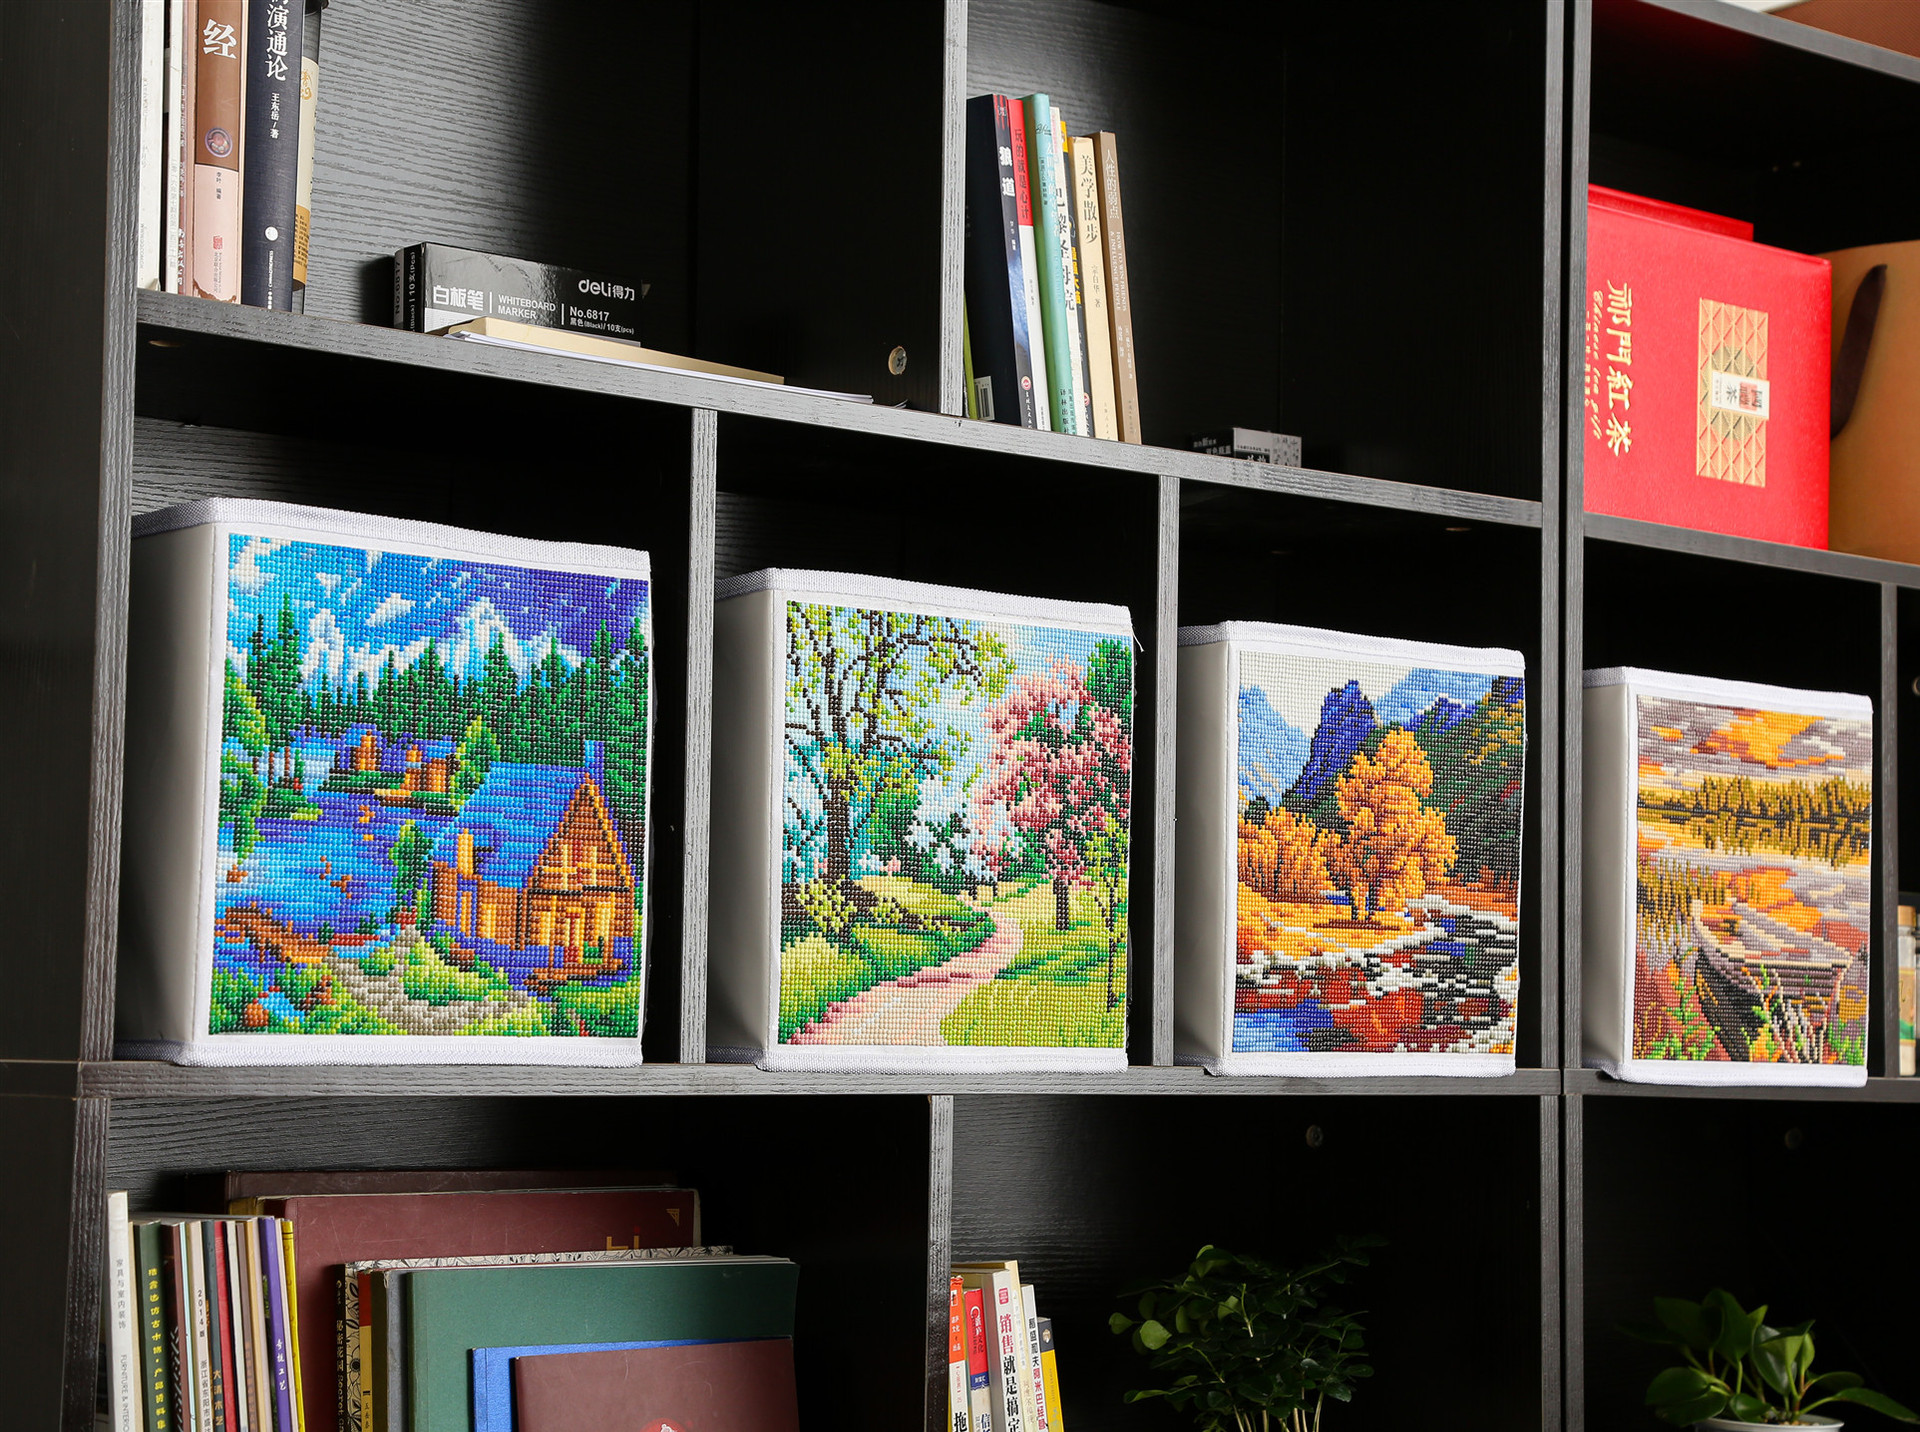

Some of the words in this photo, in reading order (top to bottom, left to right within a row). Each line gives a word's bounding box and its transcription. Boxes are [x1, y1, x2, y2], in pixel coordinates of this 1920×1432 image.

[203, 19, 237, 59] 经
[265, 0, 290, 81] 演通论
[1081, 154, 1099, 245] 美学散步
[1105, 149, 1120, 219] 人性的弱点
[433, 285, 484, 311] 白板笔
[498, 294, 556, 312] WHITEBOARD
[498, 305, 537, 320] MARKER
[569, 306, 610, 321] No.6817
[116, 1258, 126, 1330] 家具与室内装饰
[121, 1354, 129, 1394] FURNITURE
[999, 1313, 1021, 1432] 销售就是搞定
